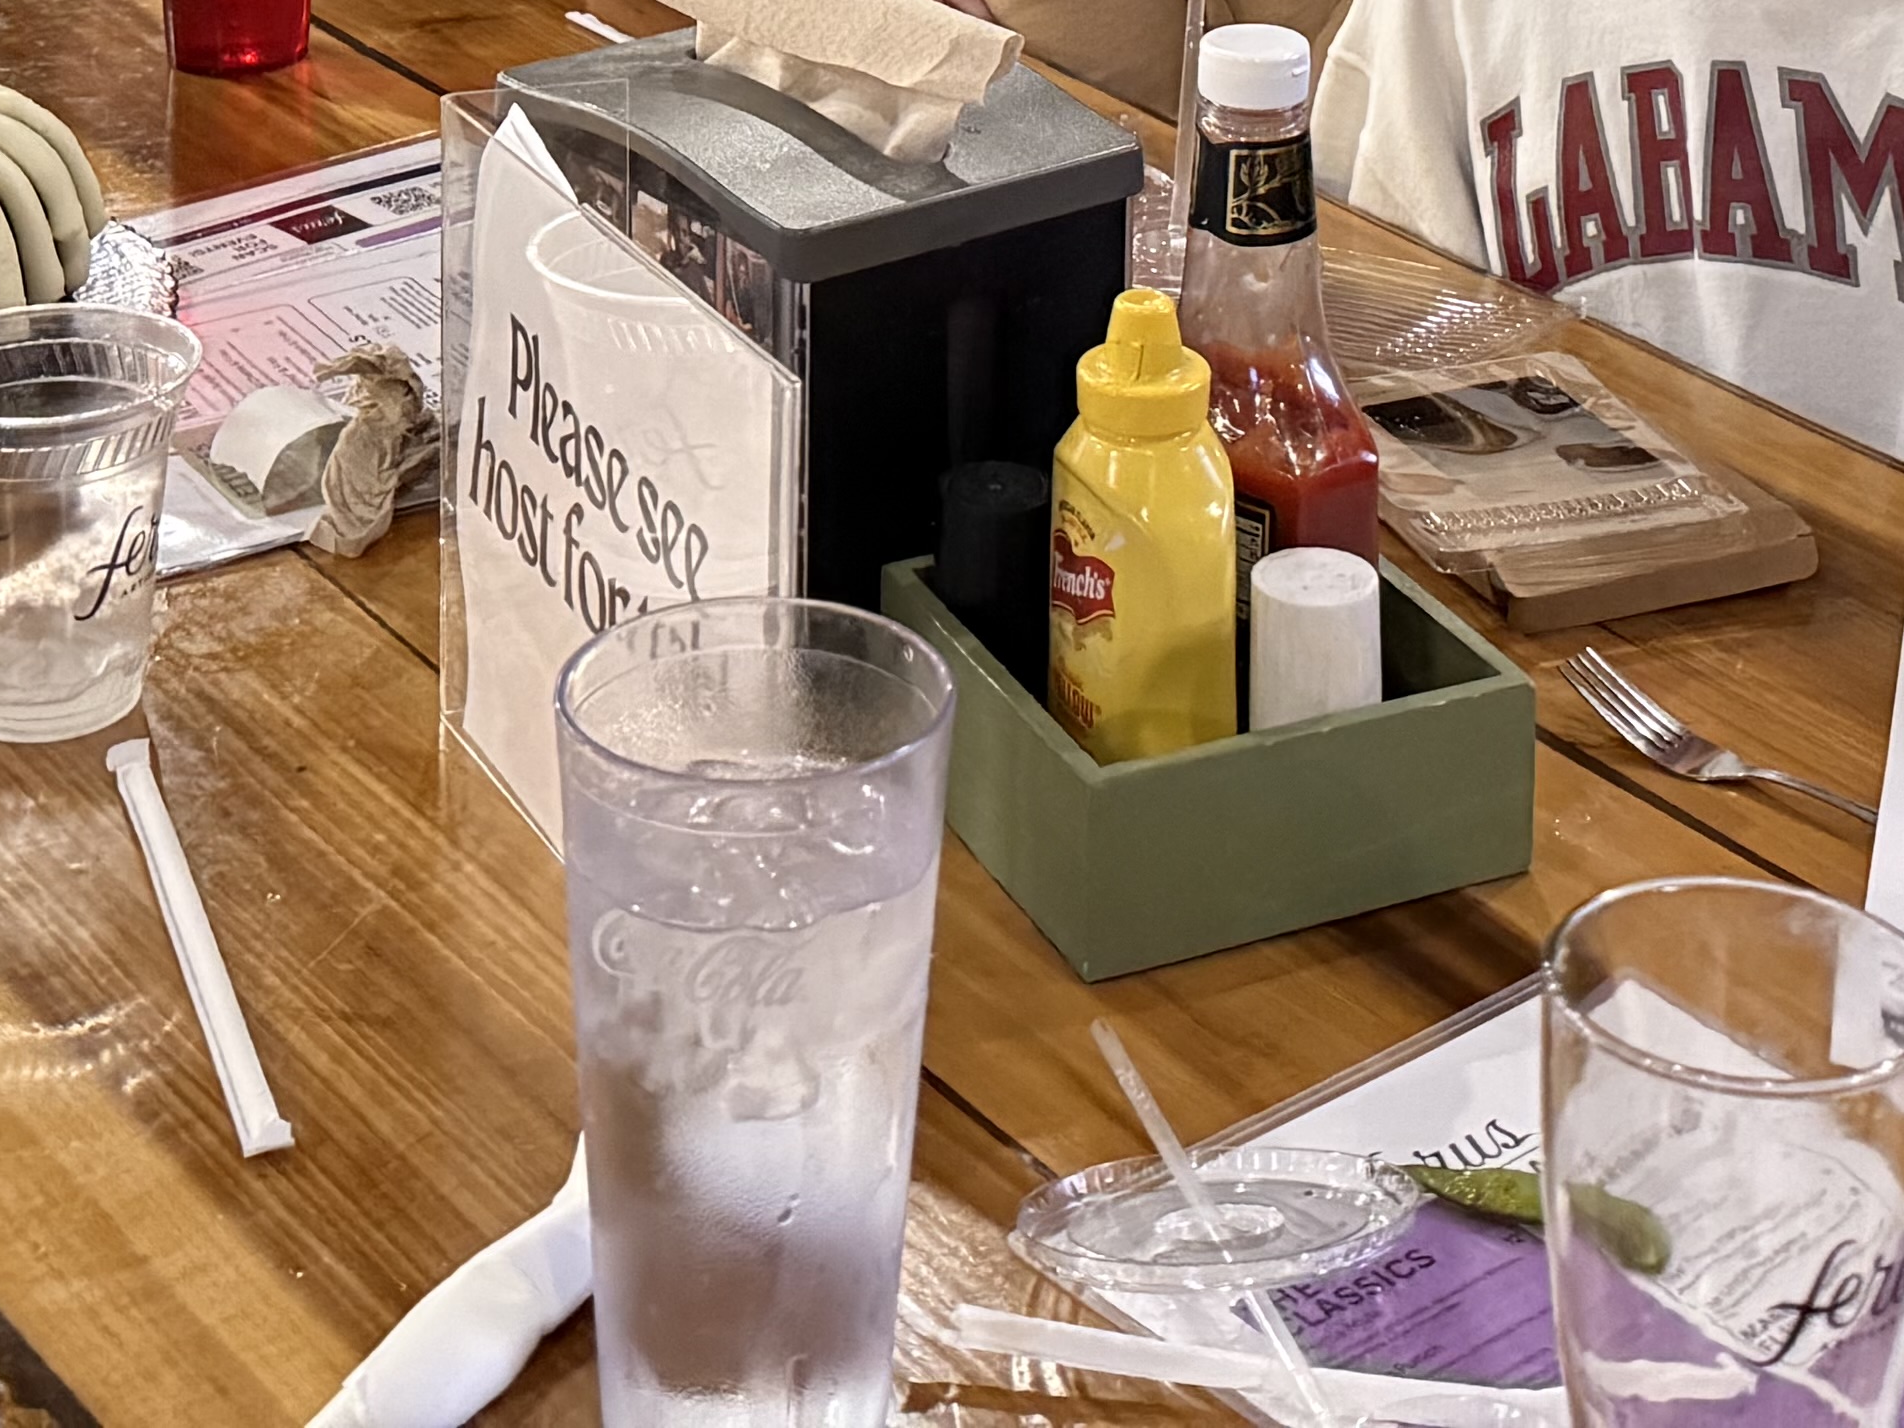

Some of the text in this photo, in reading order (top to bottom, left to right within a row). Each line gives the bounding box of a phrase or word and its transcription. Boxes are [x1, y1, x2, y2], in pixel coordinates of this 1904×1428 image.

[469, 396, 631, 634] host for
[509, 312, 630, 534] Please
[636, 475, 709, 602] see
